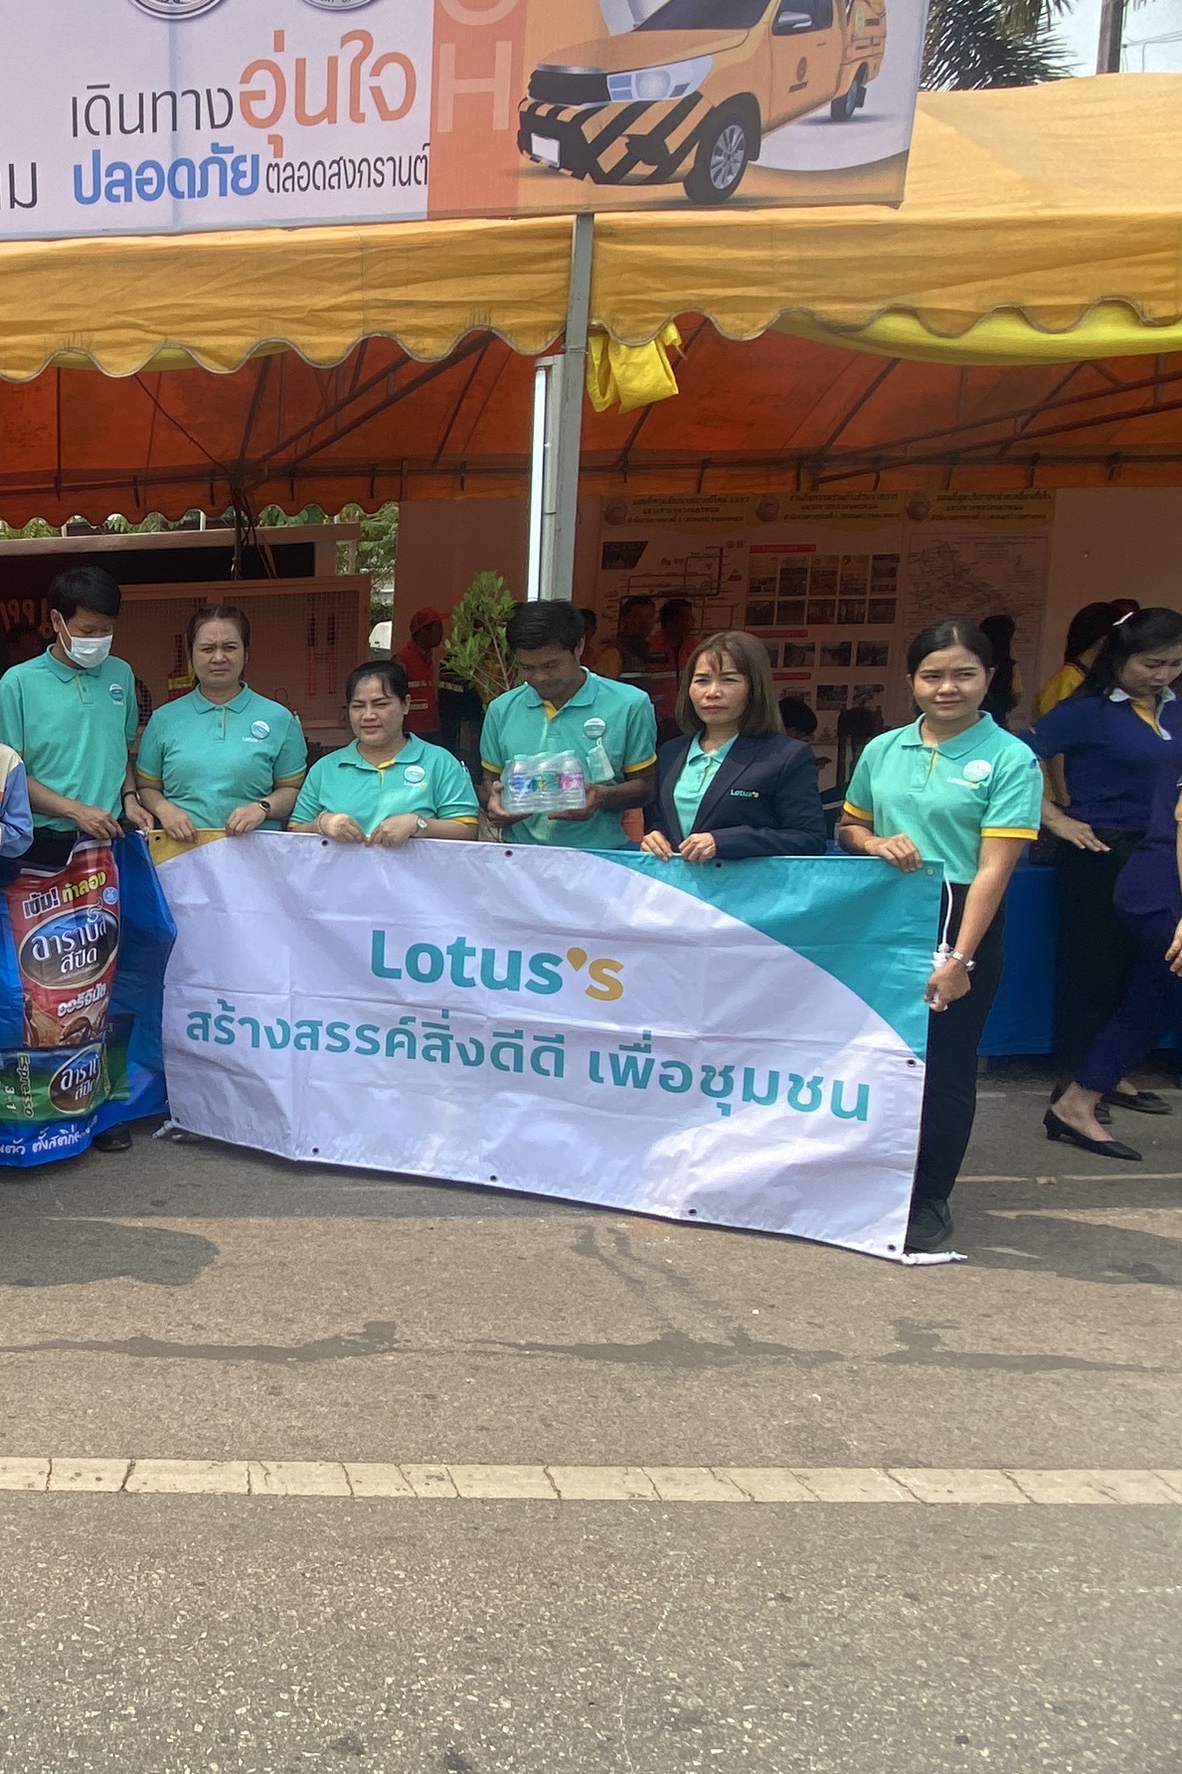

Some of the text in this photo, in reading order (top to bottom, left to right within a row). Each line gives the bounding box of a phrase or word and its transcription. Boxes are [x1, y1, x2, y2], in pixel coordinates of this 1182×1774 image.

[72, 142, 260, 205] ปลอดภัย
[370, 928, 625, 1001] Lotus's
[187, 998, 871, 1123] สร้างสรรค์สิ่งดีดี เพื่อชุมชน
